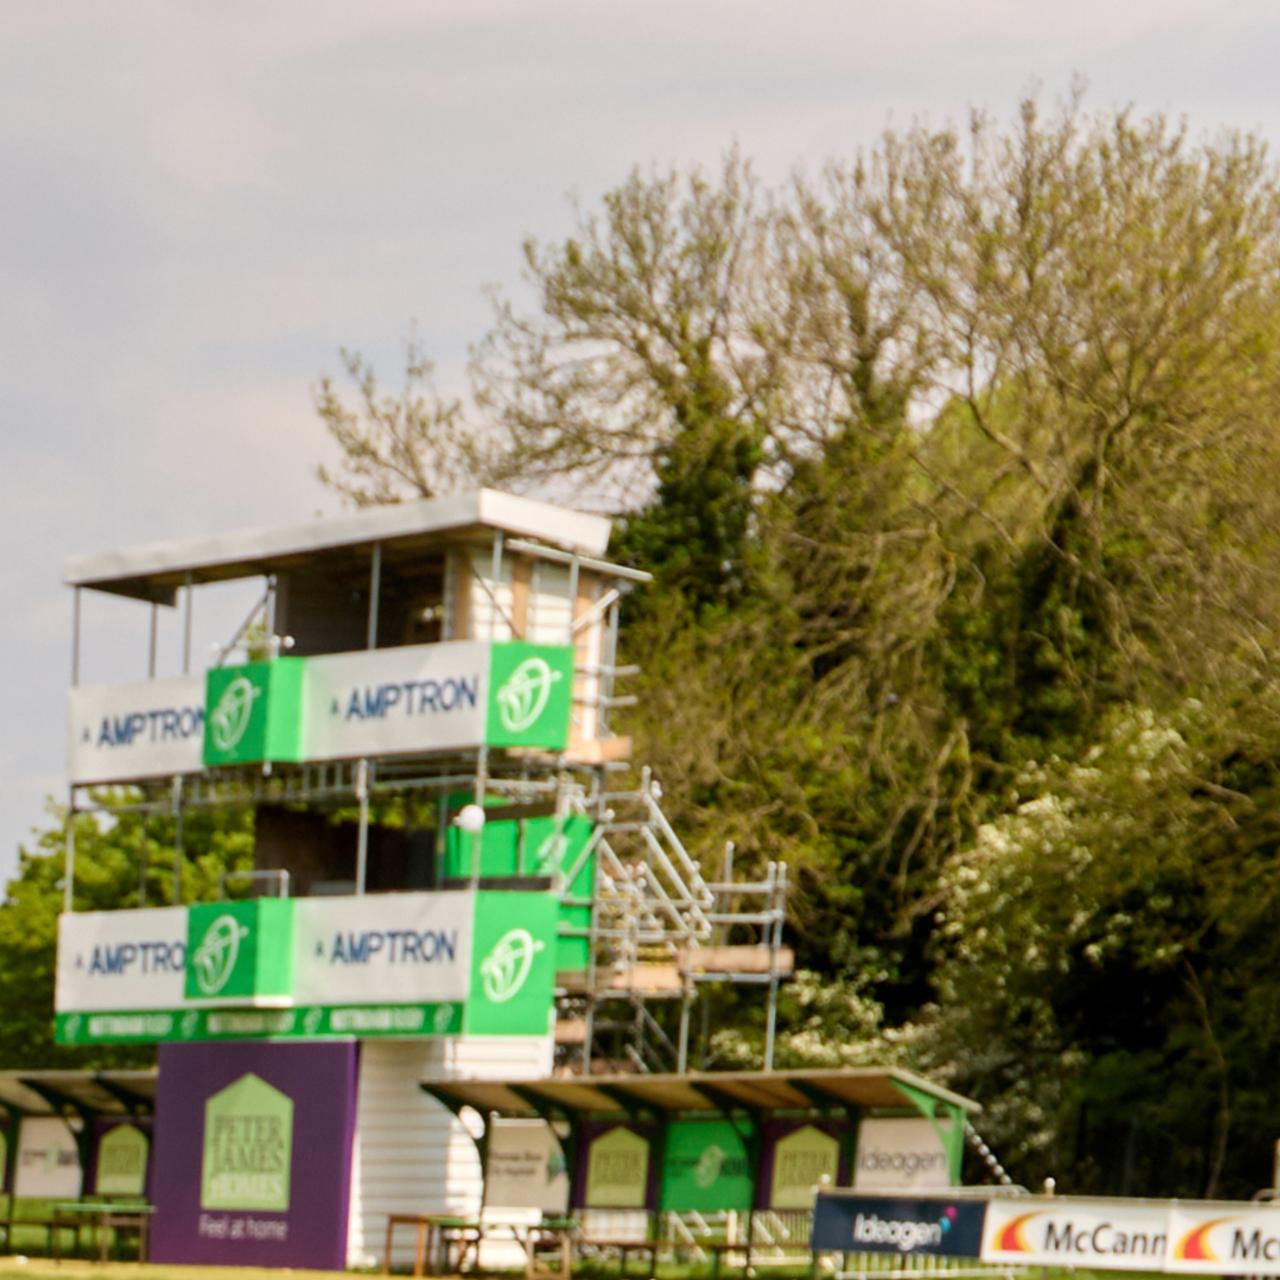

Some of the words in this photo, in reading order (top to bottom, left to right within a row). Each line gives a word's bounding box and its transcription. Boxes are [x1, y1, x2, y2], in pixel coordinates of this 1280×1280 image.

[345, 676, 478, 722] AMPTRON
[88, 941, 185, 976] AMPTRO
[329, 930, 456, 964] AMPTRON
[213, 1115, 284, 1147] PETER
[211, 1144, 284, 1175] JAMES
[853, 1212, 942, 1252] Ideagen
[1044, 1220, 1167, 1256] McCann
